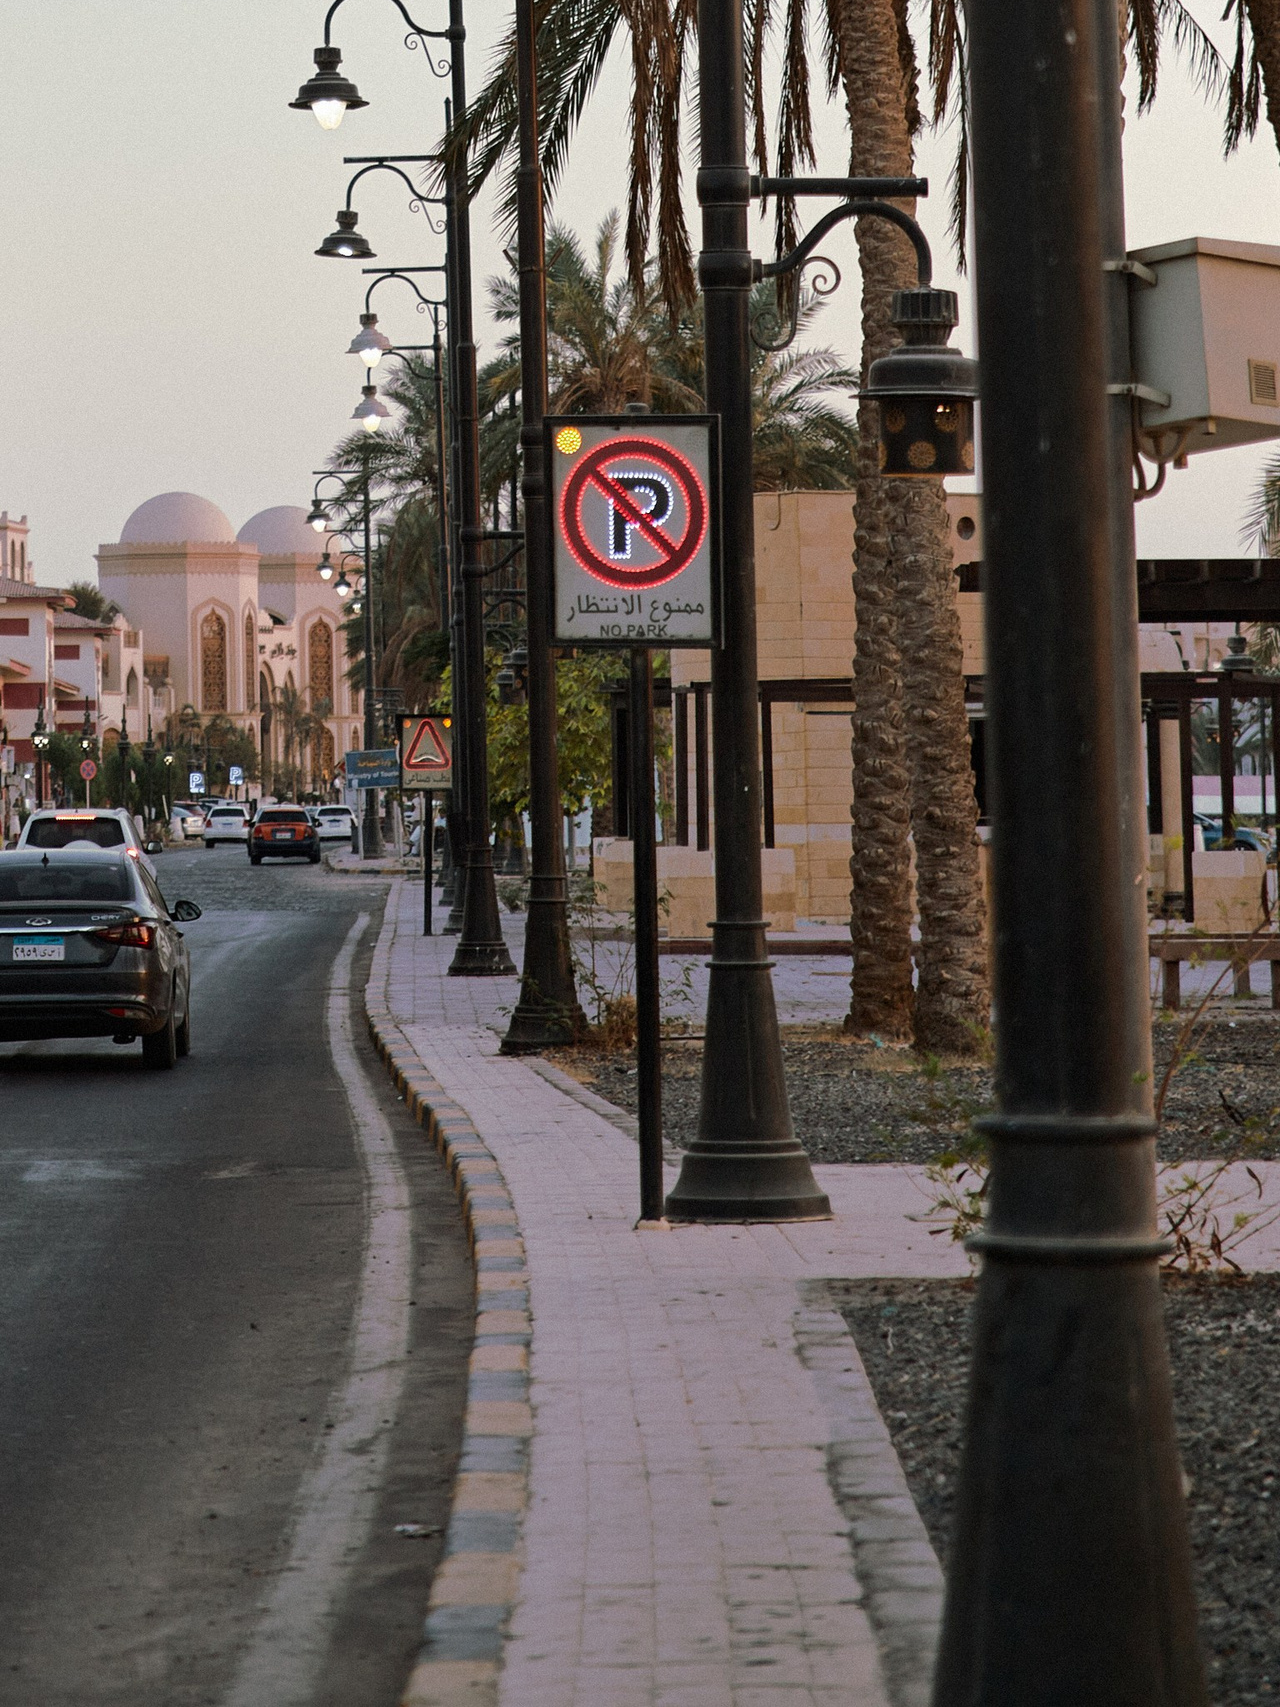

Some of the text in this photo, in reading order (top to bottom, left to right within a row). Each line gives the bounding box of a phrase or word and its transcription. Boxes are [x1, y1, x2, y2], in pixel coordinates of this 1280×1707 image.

[567, 595, 705, 622] ممنوع الانتظار
[600, 625, 668, 637] NO PARK
[189, 773, 203, 788] P
